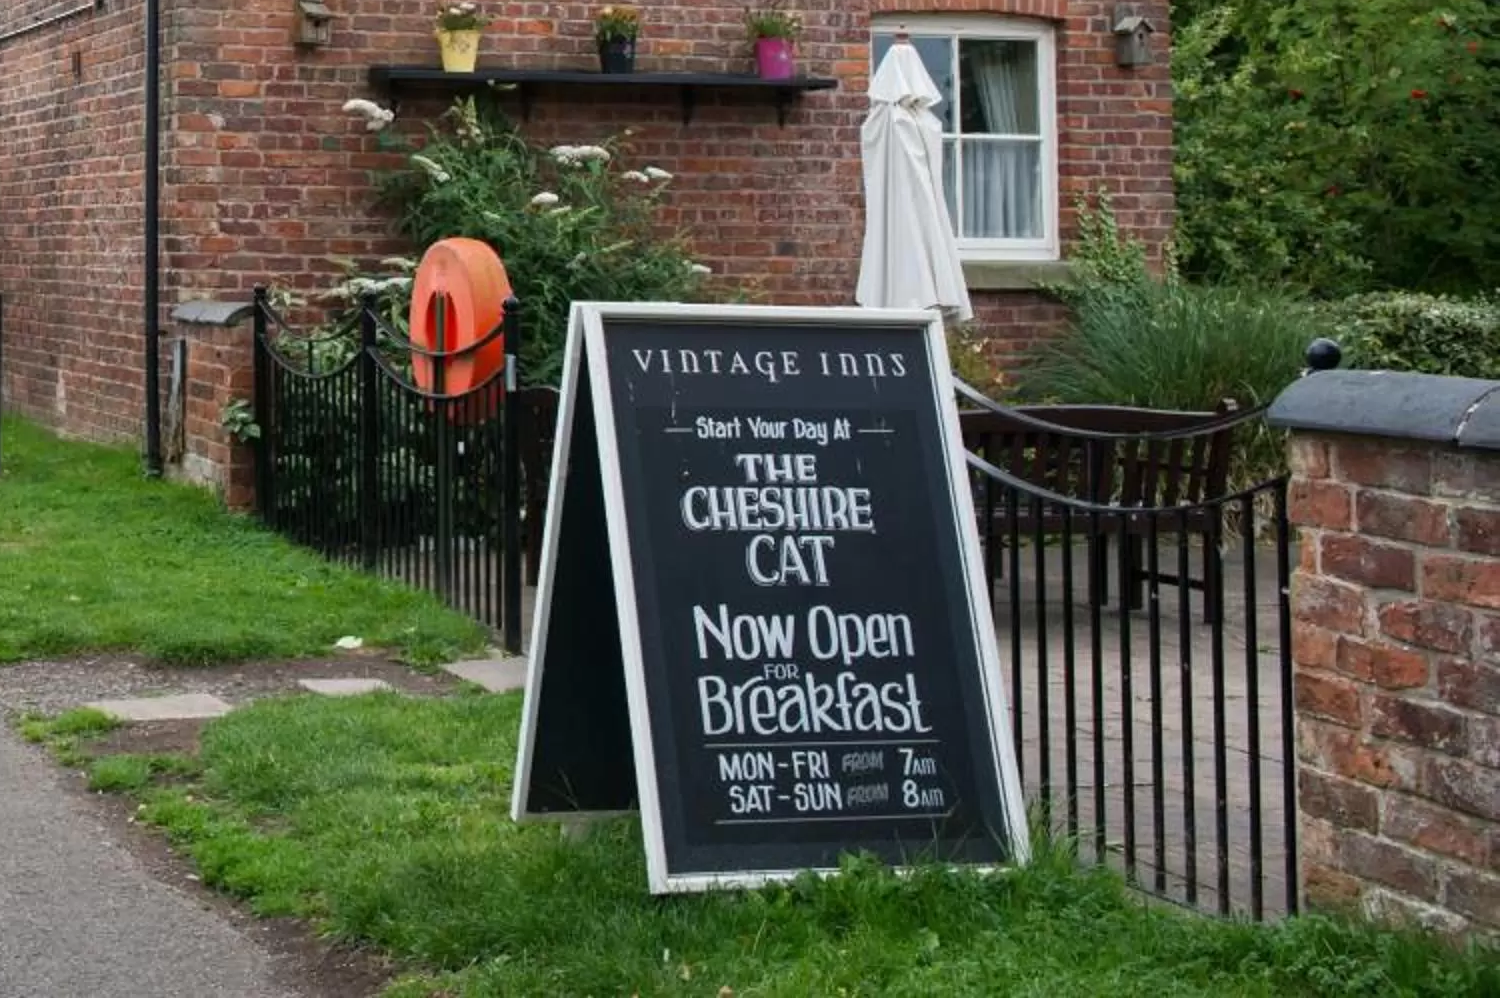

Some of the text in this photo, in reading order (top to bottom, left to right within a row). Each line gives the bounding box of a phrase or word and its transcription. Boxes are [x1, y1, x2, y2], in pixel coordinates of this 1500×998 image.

[632, 349, 907, 383] VINTAGE INNS
[696, 417, 851, 446] Start Your Day At
[735, 453, 818, 483] THE
[680, 486, 874, 531] CHESHIRE
[746, 534, 835, 586] CAT
[693, 604, 915, 665] Now Open
[764, 663, 799, 680] FOR
[698, 671, 932, 735] Breakfast
[841, 750, 885, 773] FROM
[847, 783, 889, 807] FROM
